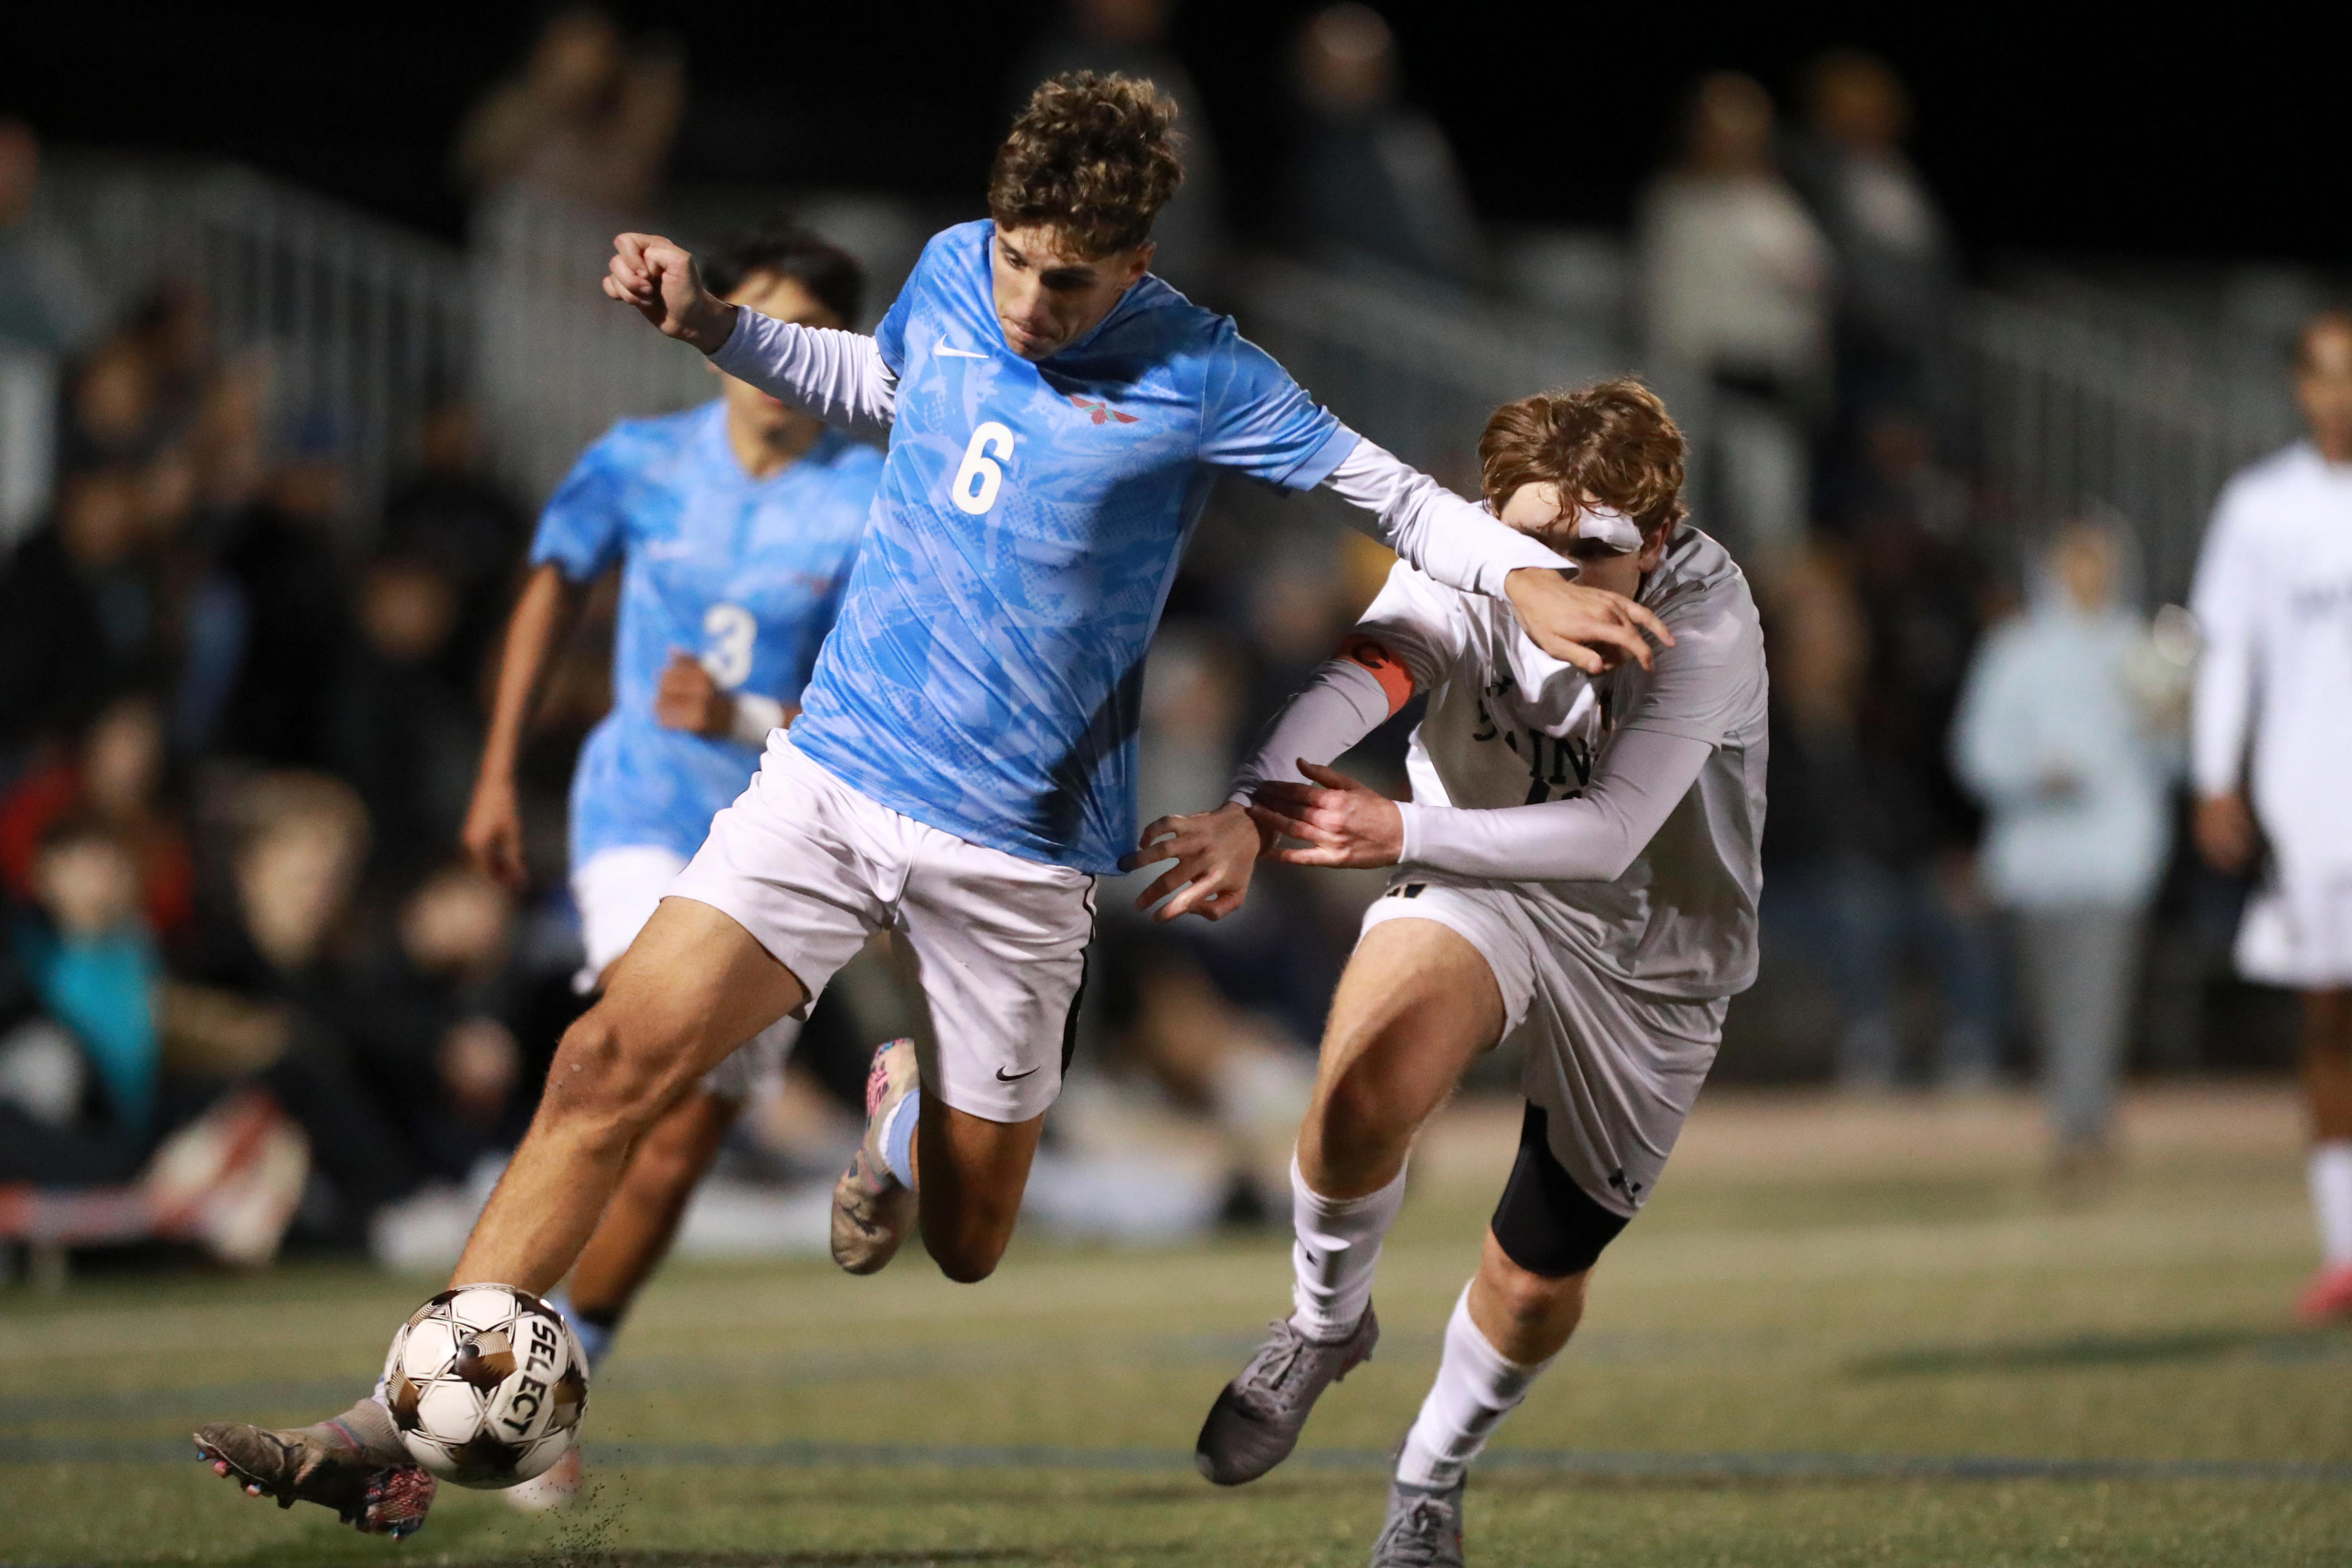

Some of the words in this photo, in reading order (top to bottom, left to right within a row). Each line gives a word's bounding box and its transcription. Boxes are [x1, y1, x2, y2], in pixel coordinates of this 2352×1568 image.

[952, 421, 1014, 515] 6
[703, 603, 756, 688] 3
[1349, 640, 1389, 669] C
[502, 1321, 558, 1435] SELECT
